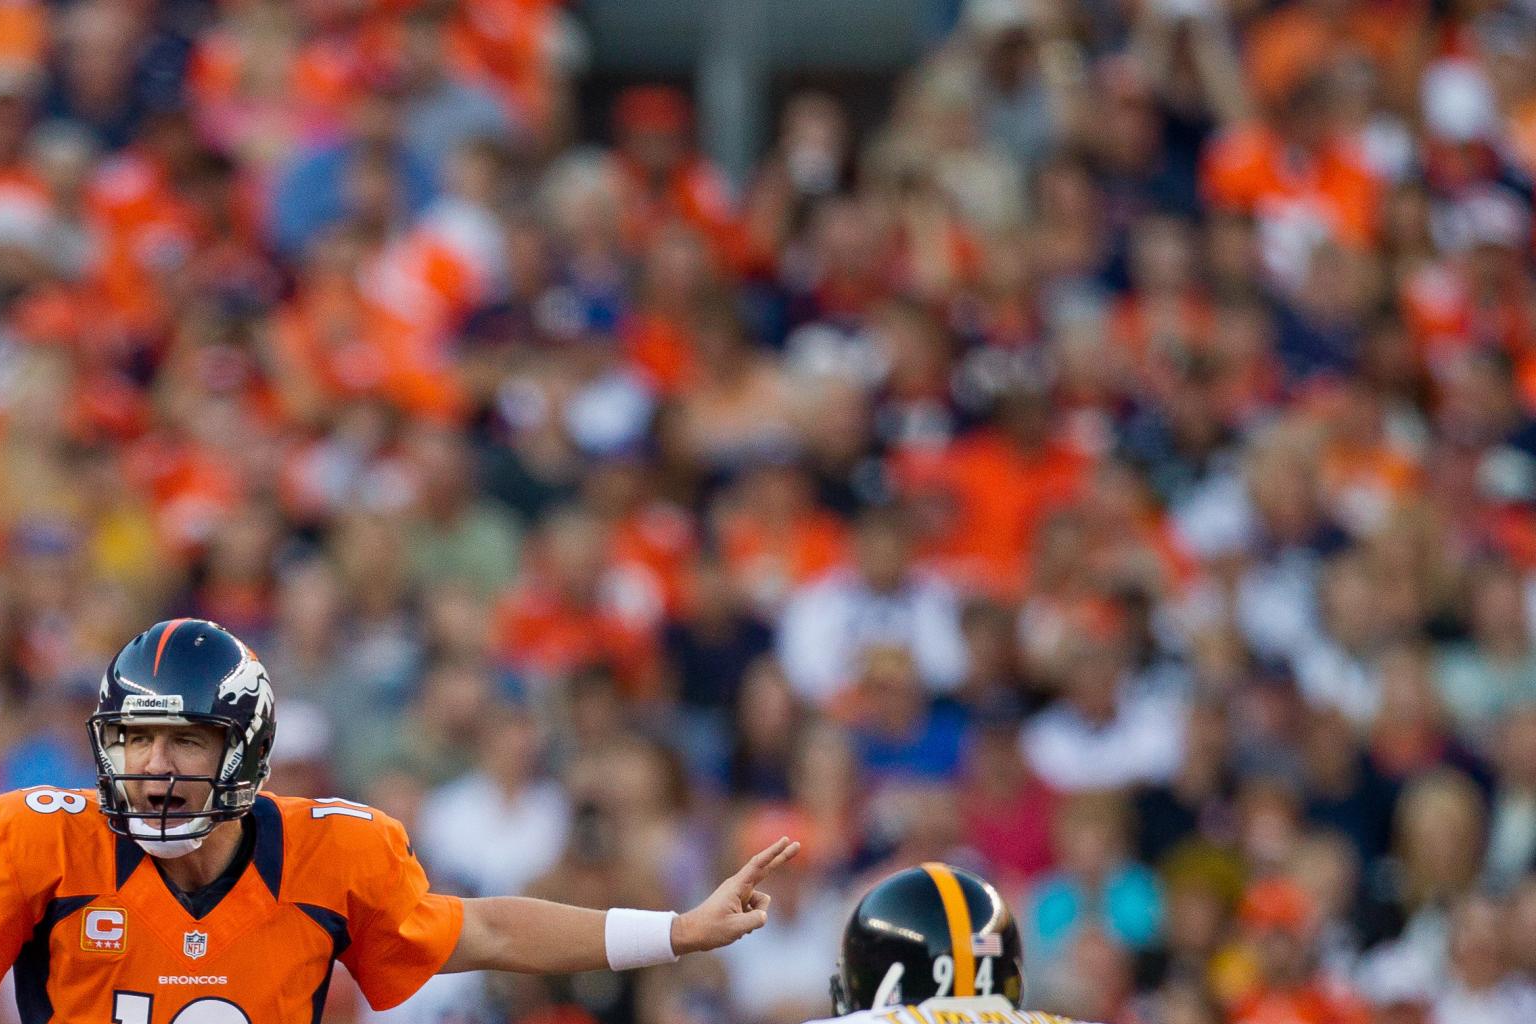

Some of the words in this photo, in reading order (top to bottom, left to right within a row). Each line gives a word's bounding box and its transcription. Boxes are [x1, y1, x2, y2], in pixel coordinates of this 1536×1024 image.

[136, 698, 168, 708] Riddell
[222, 752, 243, 780] iddell
[23, 785, 89, 815] 8
[86, 911, 124, 940] C
[187, 943, 203, 954] NFL
[158, 975, 228, 985] BRONCOS
[932, 954, 994, 997] 94
